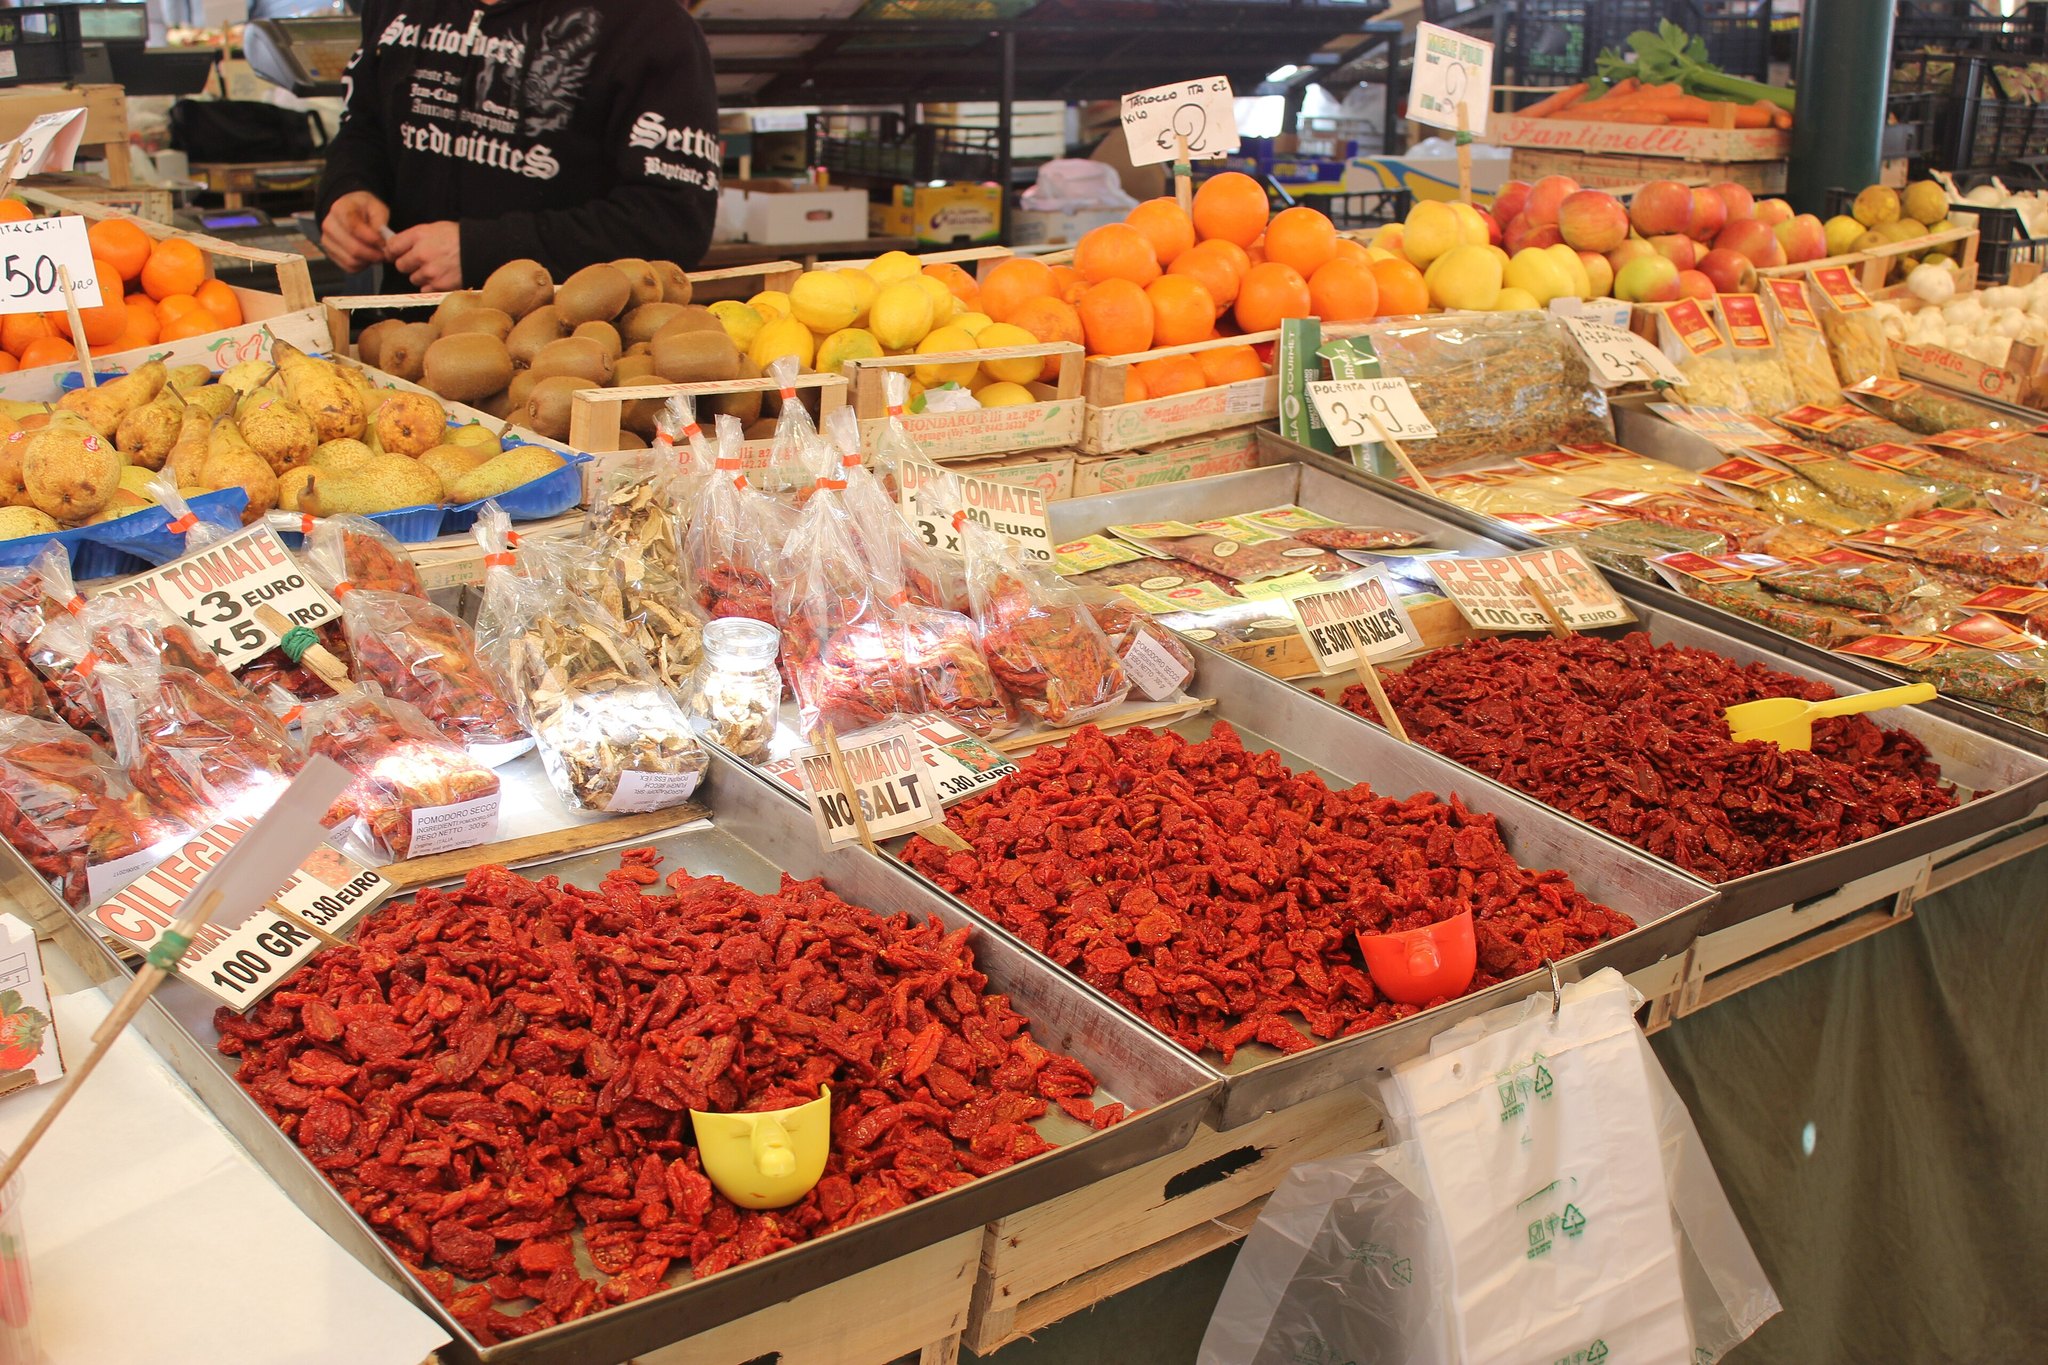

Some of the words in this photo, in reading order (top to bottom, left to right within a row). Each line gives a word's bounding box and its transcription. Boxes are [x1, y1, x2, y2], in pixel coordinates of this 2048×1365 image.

[1187, 84, 1205, 96] ITA
[1503, 121, 1692, 152] Fantinelli
[1286, 331, 1296, 393] GOURMET
[1313, 383, 1367, 395] POLENTA
[1372, 380, 1404, 391] ITALIA
[994, 521, 1046, 539] EURO
[160, 534, 287, 600] TOMATE
[1428, 549, 1588, 582] PEPITA
[200, 590, 242, 623] 3
[241, 574, 305, 607] EURO
[1446, 580, 1485, 597] ORO
[1485, 580, 1503, 597] DI
[1503, 577, 1570, 597] SICLIA
[1295, 596, 1329, 627] DRY
[1323, 579, 1388, 620] TOMATO
[1471, 608, 1520, 626] 100
[1579, 610, 1618, 623] EURO
[230, 619, 267, 651] 5
[1310, 627, 1333, 657] NE
[1137, 640, 1165, 668] POMODORO
[803, 755, 840, 793] DRY
[841, 738, 912, 786] OMATO
[973, 765, 1021, 783] EURO
[417, 809, 469, 826] POMODORO
[470, 802, 498, 816] SECCO
[818, 792, 855, 829] NO
[855, 773, 922, 822] SALT
[416, 832, 438, 843] PESO
[438, 826, 463, 838] NETTO
[468, 822, 480, 832] 300
[211, 949, 272, 995] 100
[256, 920, 312, 959] GR
[343, 870, 380, 906] EURO
